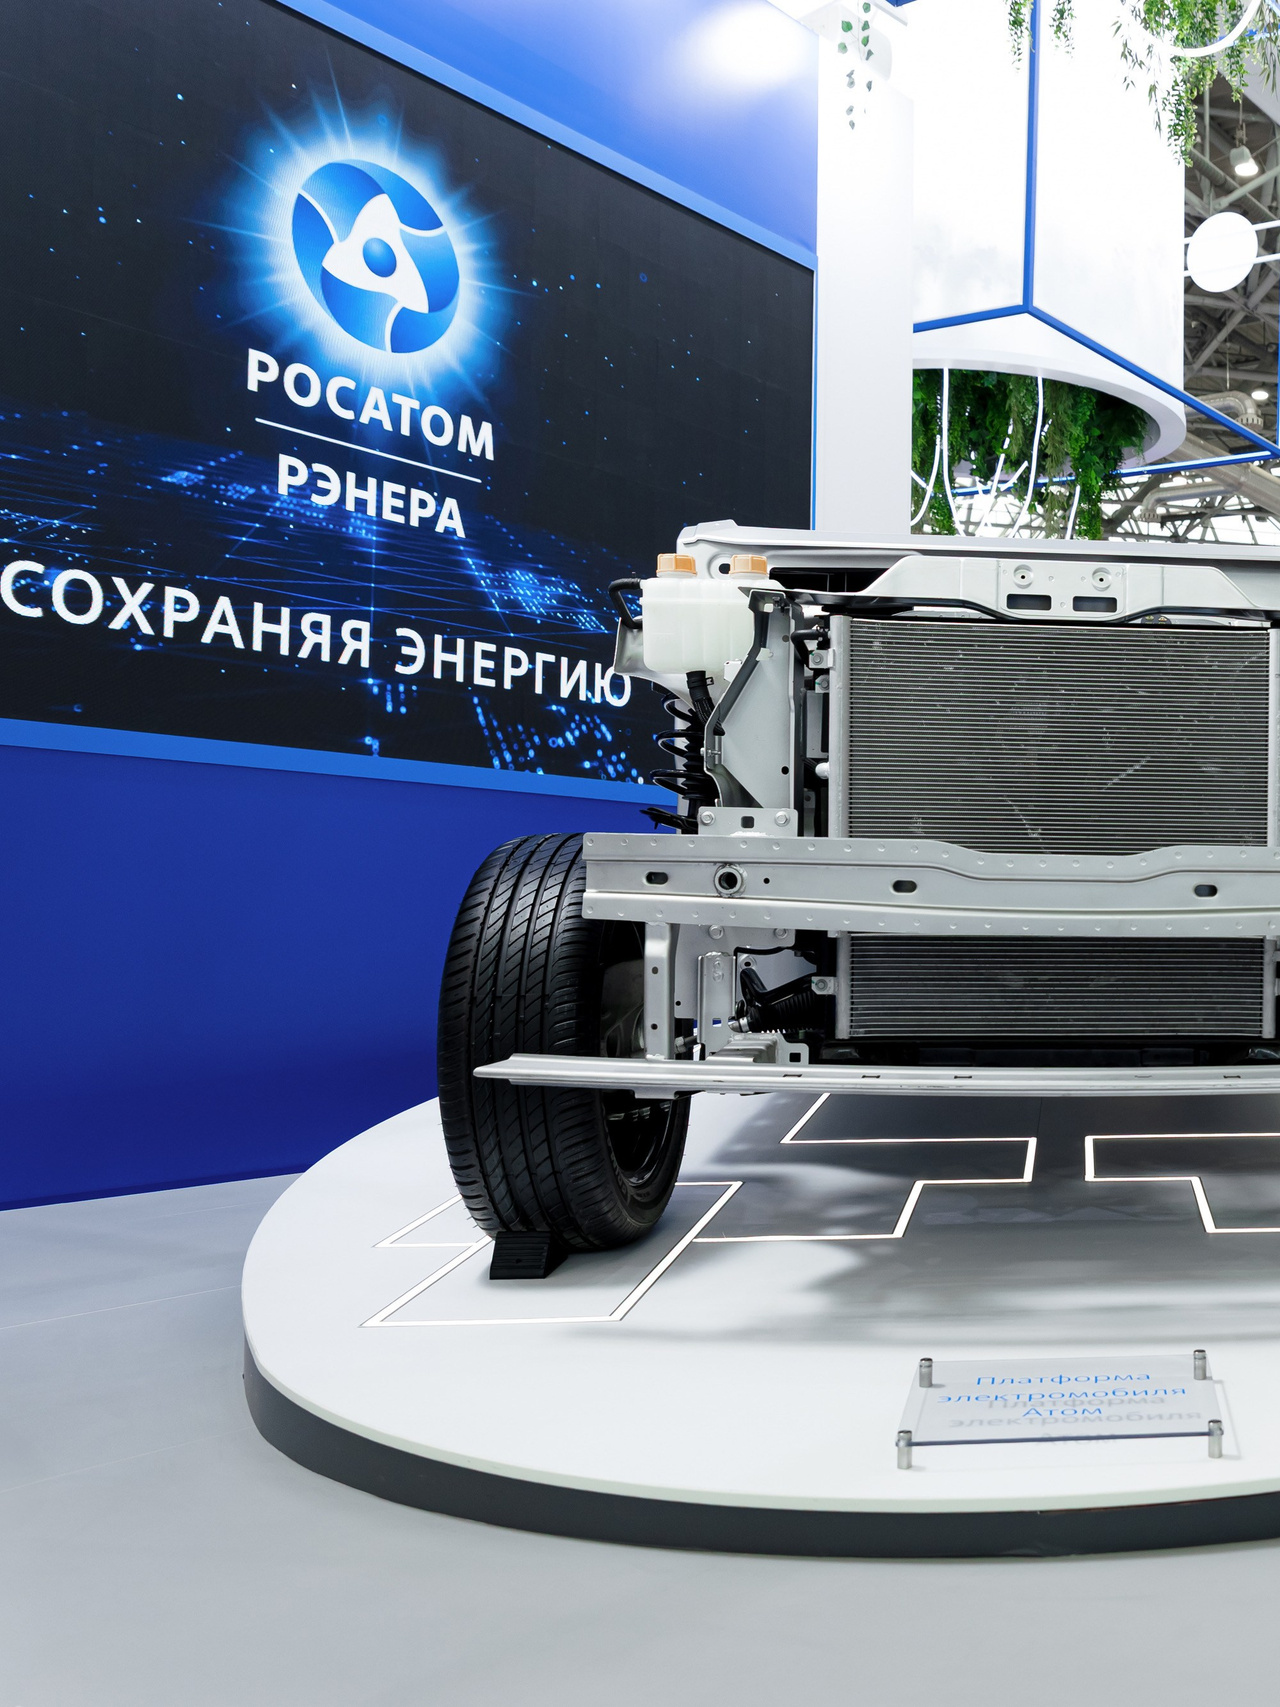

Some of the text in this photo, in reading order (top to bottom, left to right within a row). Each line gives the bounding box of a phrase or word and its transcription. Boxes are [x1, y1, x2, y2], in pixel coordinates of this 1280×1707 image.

[247, 348, 495, 460] РОСАТОМ
[277, 453, 466, 538] РЭНЕРА
[0, 560, 631, 707] СОХРАНЯЯ ЭНЕРГИЮ
[938, 1387, 1187, 1403] электромобиля
[976, 1374, 1150, 1386] Платформа
[1023, 1407, 1102, 1417] Атом
